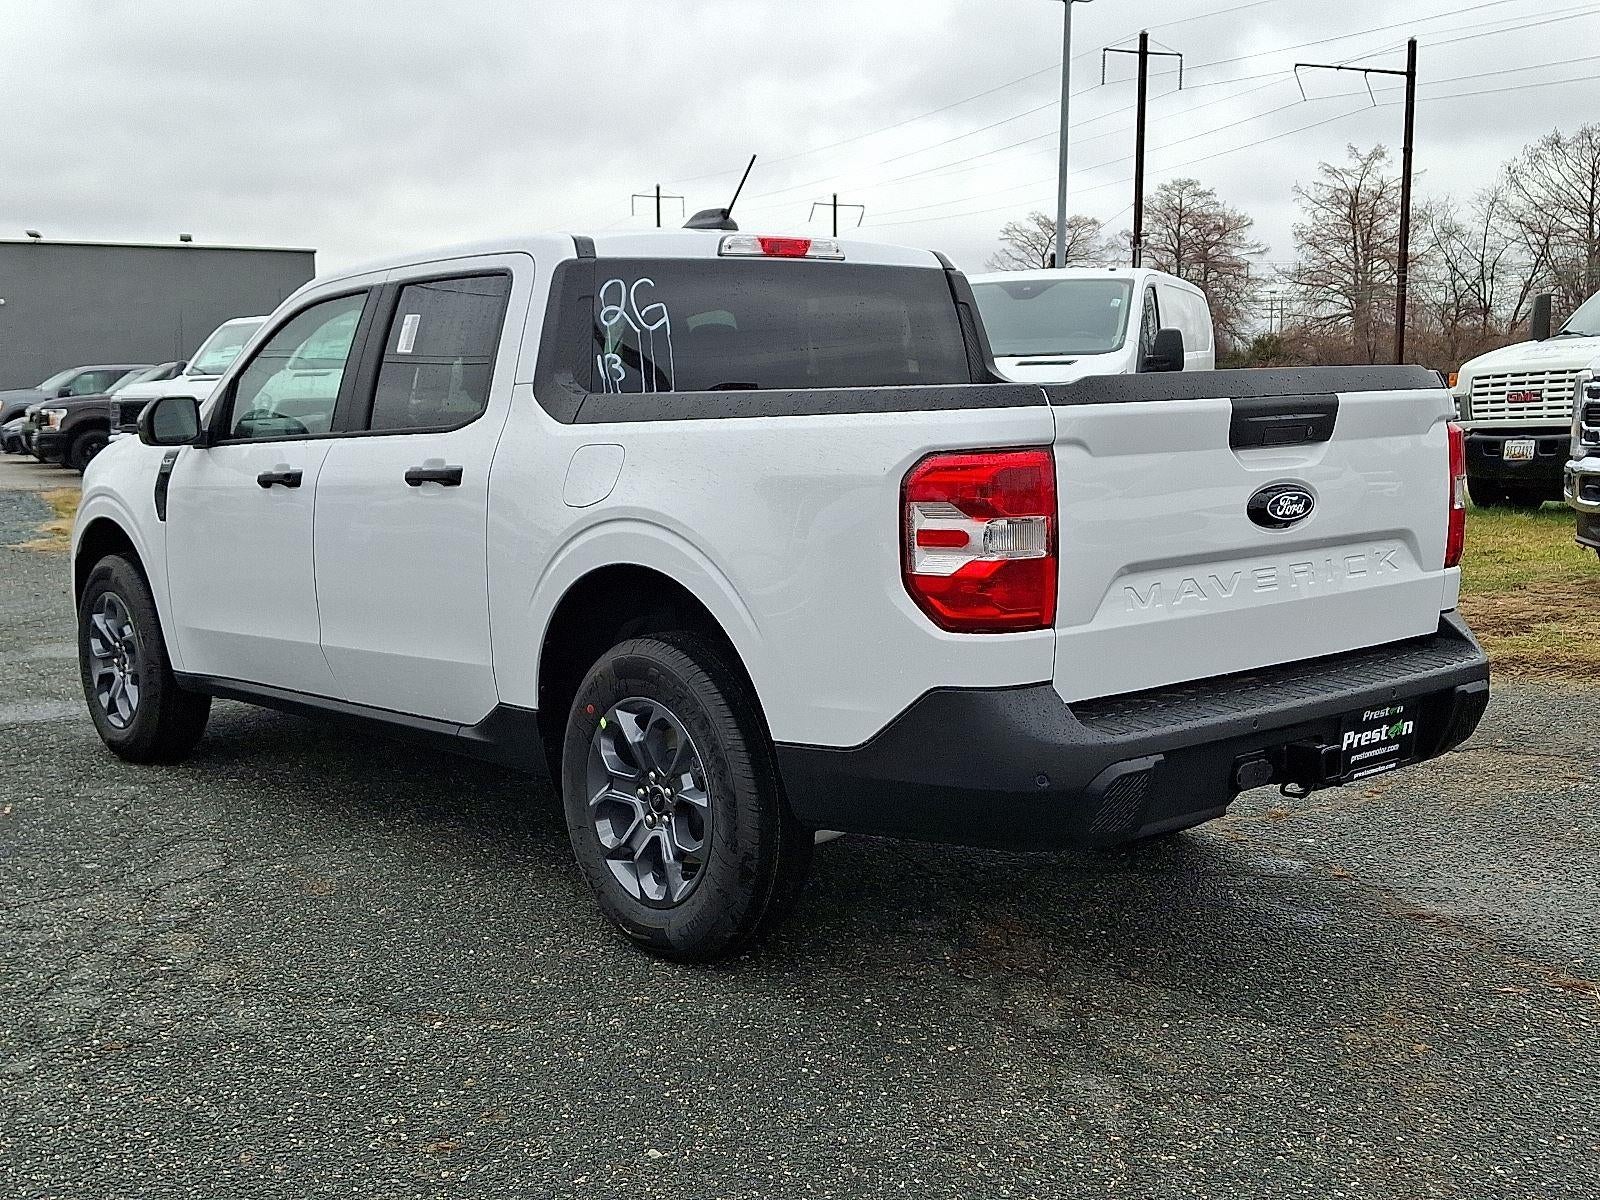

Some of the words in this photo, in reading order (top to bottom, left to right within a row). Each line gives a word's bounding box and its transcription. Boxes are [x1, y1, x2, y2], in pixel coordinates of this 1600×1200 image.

[1508, 391, 1541, 401] GMC
[1276, 496, 1306, 515] Ford
[1124, 549, 1399, 611] MAVERICK
[1342, 719, 1413, 751] Preston
